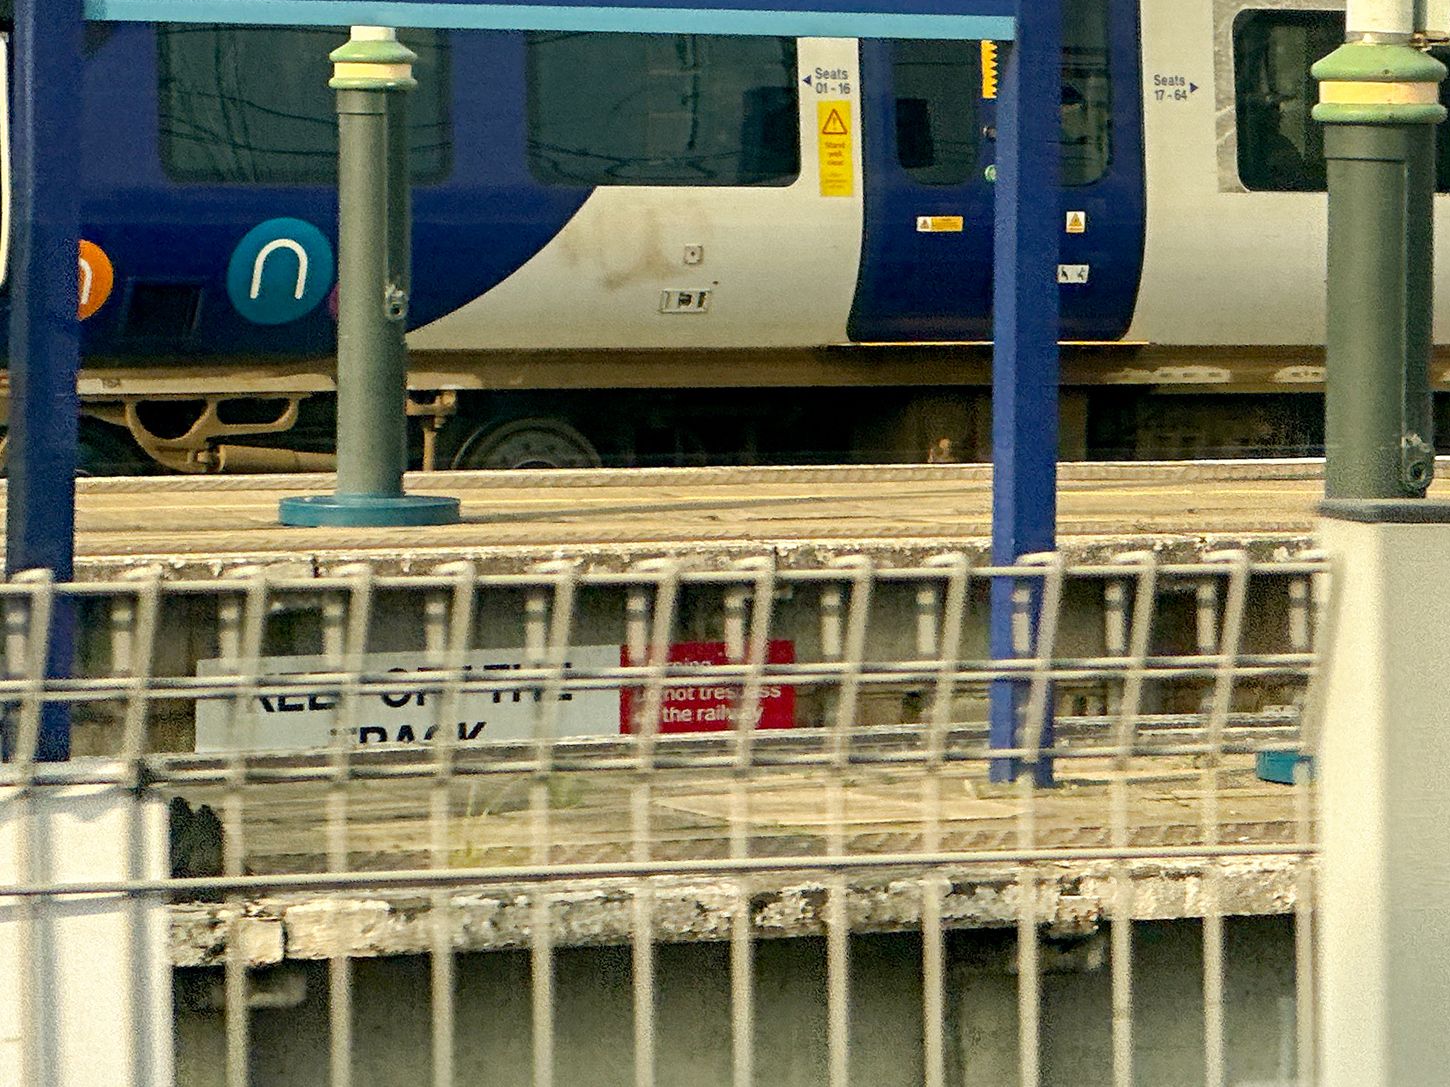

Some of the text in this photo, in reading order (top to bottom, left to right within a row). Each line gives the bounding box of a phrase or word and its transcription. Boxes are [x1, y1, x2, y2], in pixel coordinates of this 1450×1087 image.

[815, 67, 848, 80] Seats
[1153, 74, 1186, 87] Seats
[663, 707, 693, 723] the
